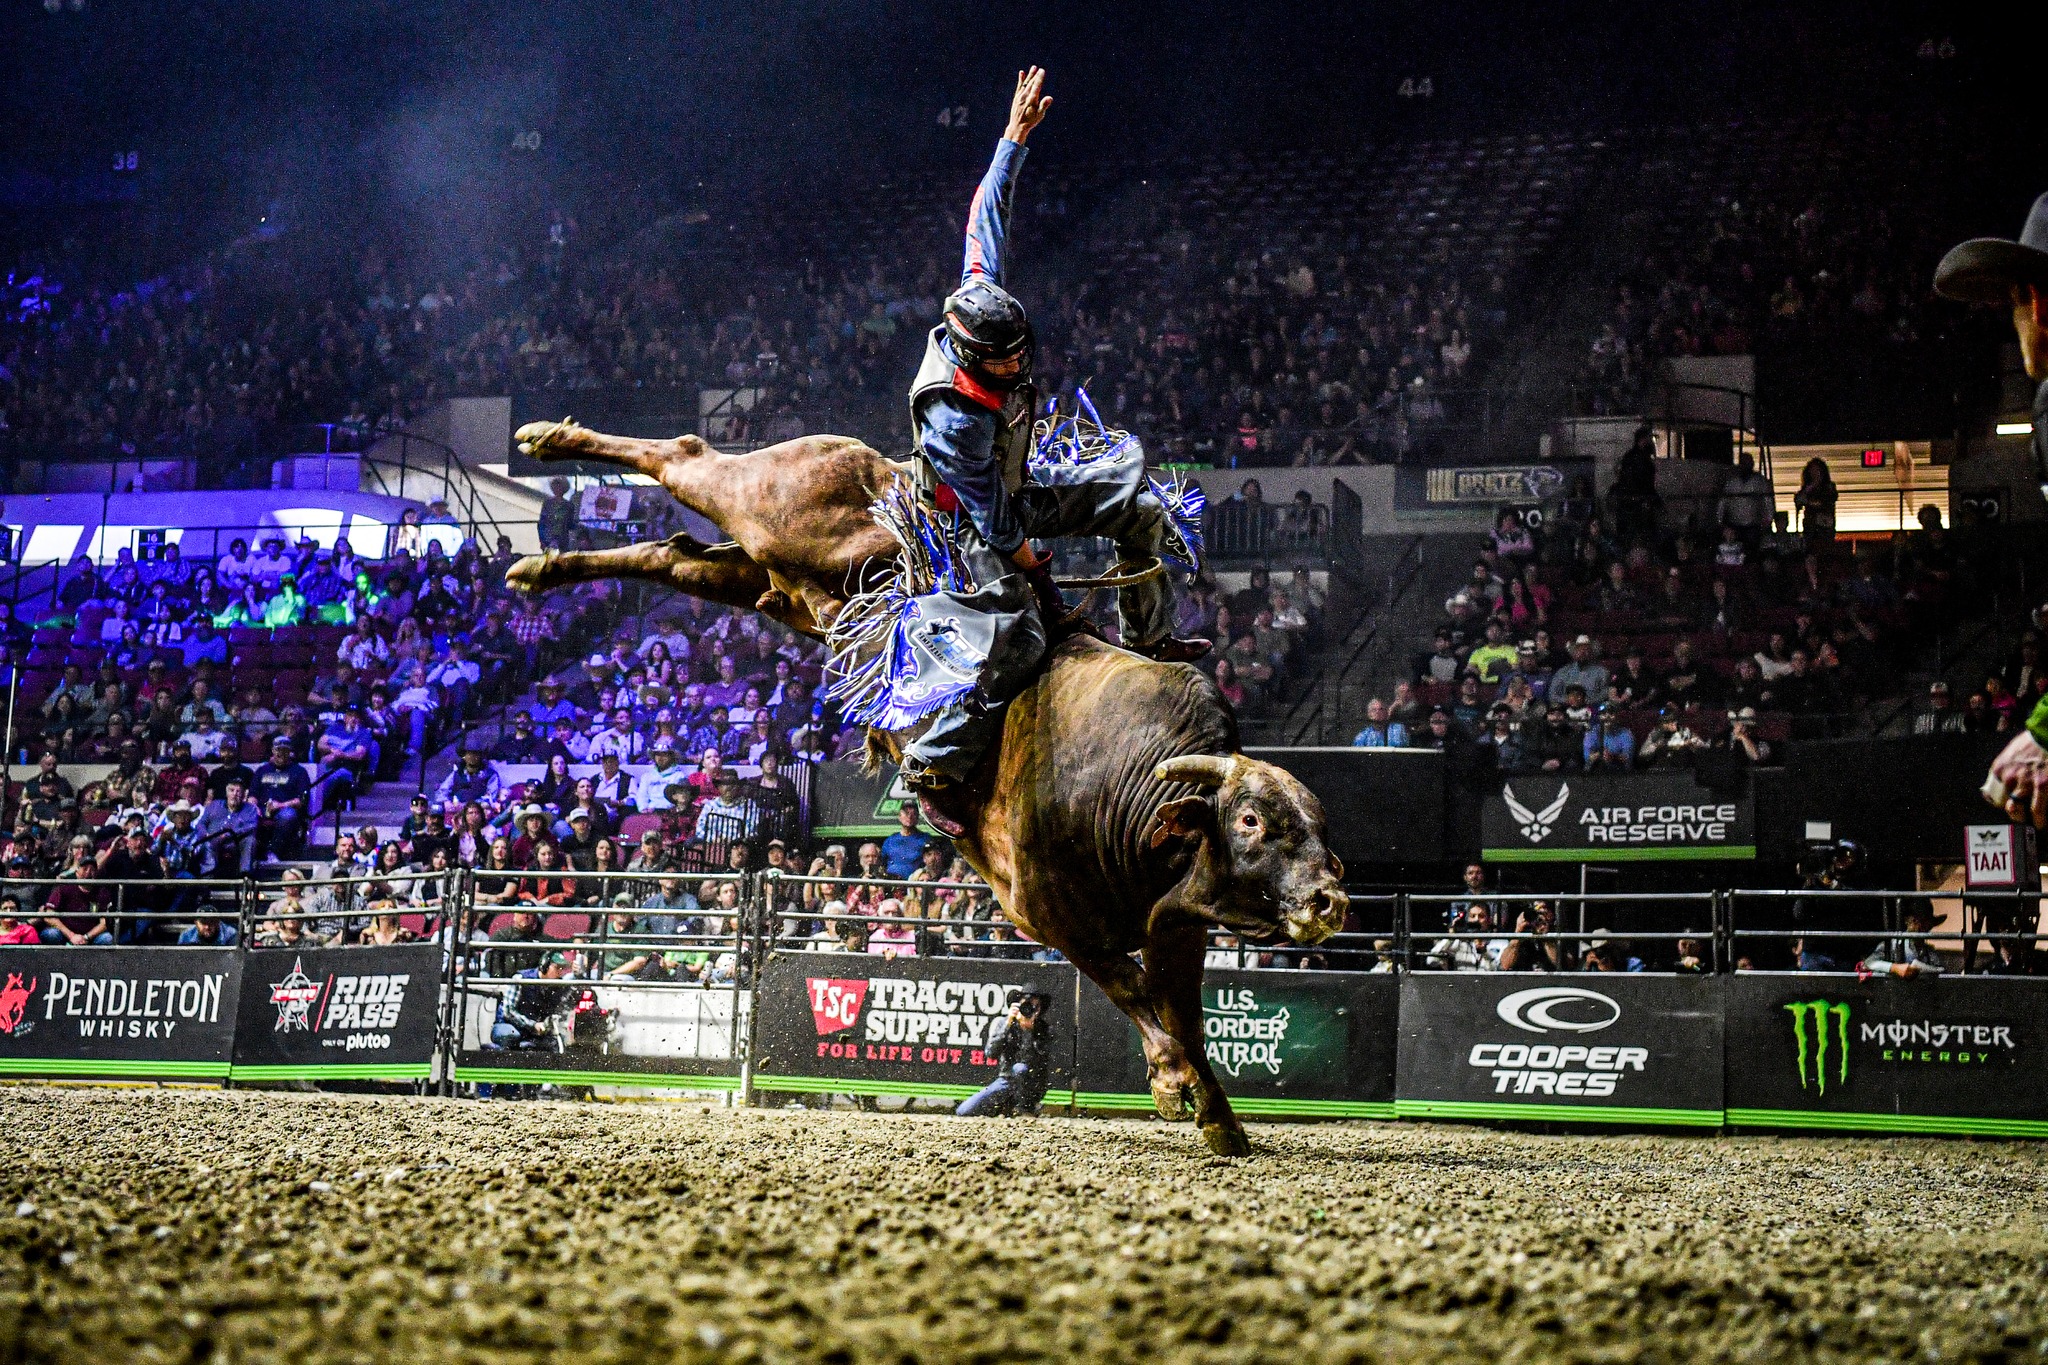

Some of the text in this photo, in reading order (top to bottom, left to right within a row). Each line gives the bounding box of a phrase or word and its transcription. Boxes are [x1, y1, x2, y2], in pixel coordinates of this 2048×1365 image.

[1396, 78, 1432, 97] 44
[936, 106, 969, 127] 42
[113, 150, 139, 170] 38
[1517, 509, 1543, 528] 0
[1579, 804, 1736, 825] AIR FORCE
[1588, 822, 1726, 843] RESERVE
[1971, 851, 2008, 872] TAAT
[43, 971, 223, 1023] PENDLETON
[330, 974, 410, 1005] RIDE
[1217, 988, 1260, 1011] U.S.
[812, 979, 857, 1026] TSC
[322, 1002, 401, 1030] PASS
[79, 1019, 176, 1039] WHISKY
[865, 1009, 988, 1047] SUPPLY
[1203, 1016, 1285, 1040] ORDER
[1860, 1018, 2016, 1049] MONSTER
[816, 1042, 859, 1059] FOR
[866, 1044, 913, 1062] LIFE
[920, 1047, 963, 1064] OUT
[1203, 1041, 1283, 1065] ATROL
[1468, 1043, 1649, 1072] COOPER
[1882, 1049, 1989, 1064] ENERGY
[1491, 1069, 1620, 1097] TIRES
